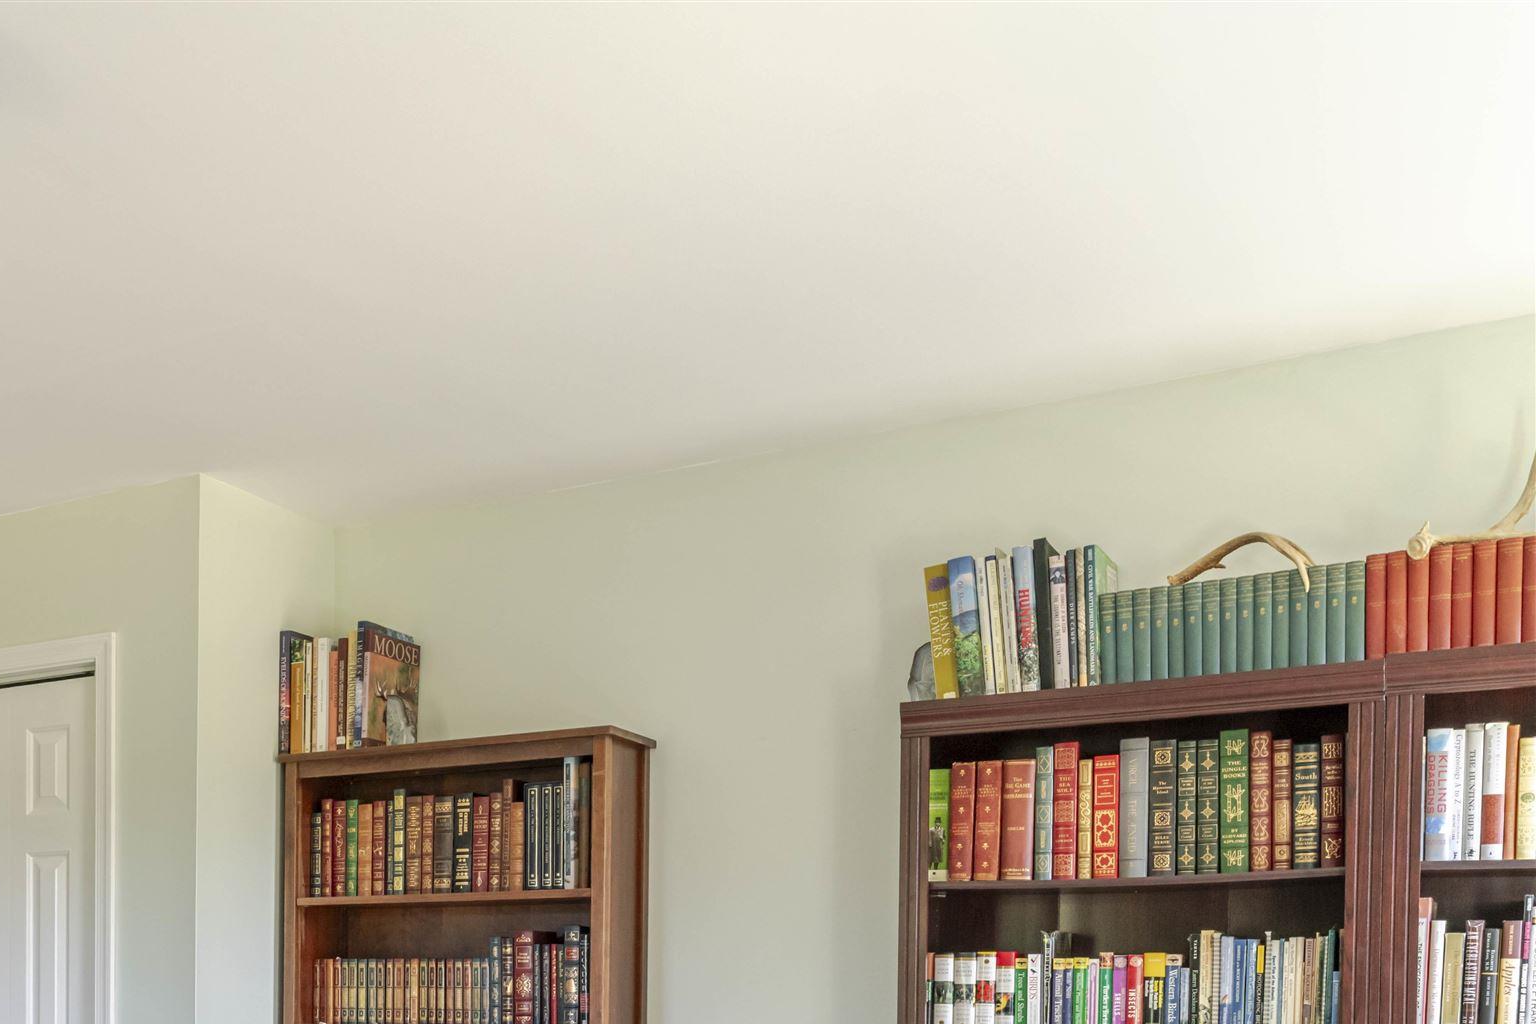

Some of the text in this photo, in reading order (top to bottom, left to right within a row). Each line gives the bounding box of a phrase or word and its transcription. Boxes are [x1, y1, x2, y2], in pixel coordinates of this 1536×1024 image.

[928, 603, 943, 658] FLOWERS
[939, 601, 951, 644] PLANTS
[375, 635, 419, 665] MOOSE
[1295, 772, 1317, 781] South
[1427, 755, 1435, 814] DRAGONS
[1437, 755, 1448, 813] KILLING
[1467, 772, 1475, 811] HUNTING
[1029, 976, 1039, 1000] BIRDS
[1463, 931, 1479, 1005] AN EVERLASTING MEAL
[1017, 972, 1025, 1022] Trees and Shrubs
[1054, 973, 1062, 1023] Animal Tracks
[1128, 989, 1136, 1018] INSECTS
[1167, 969, 1178, 1023] Western Birds
